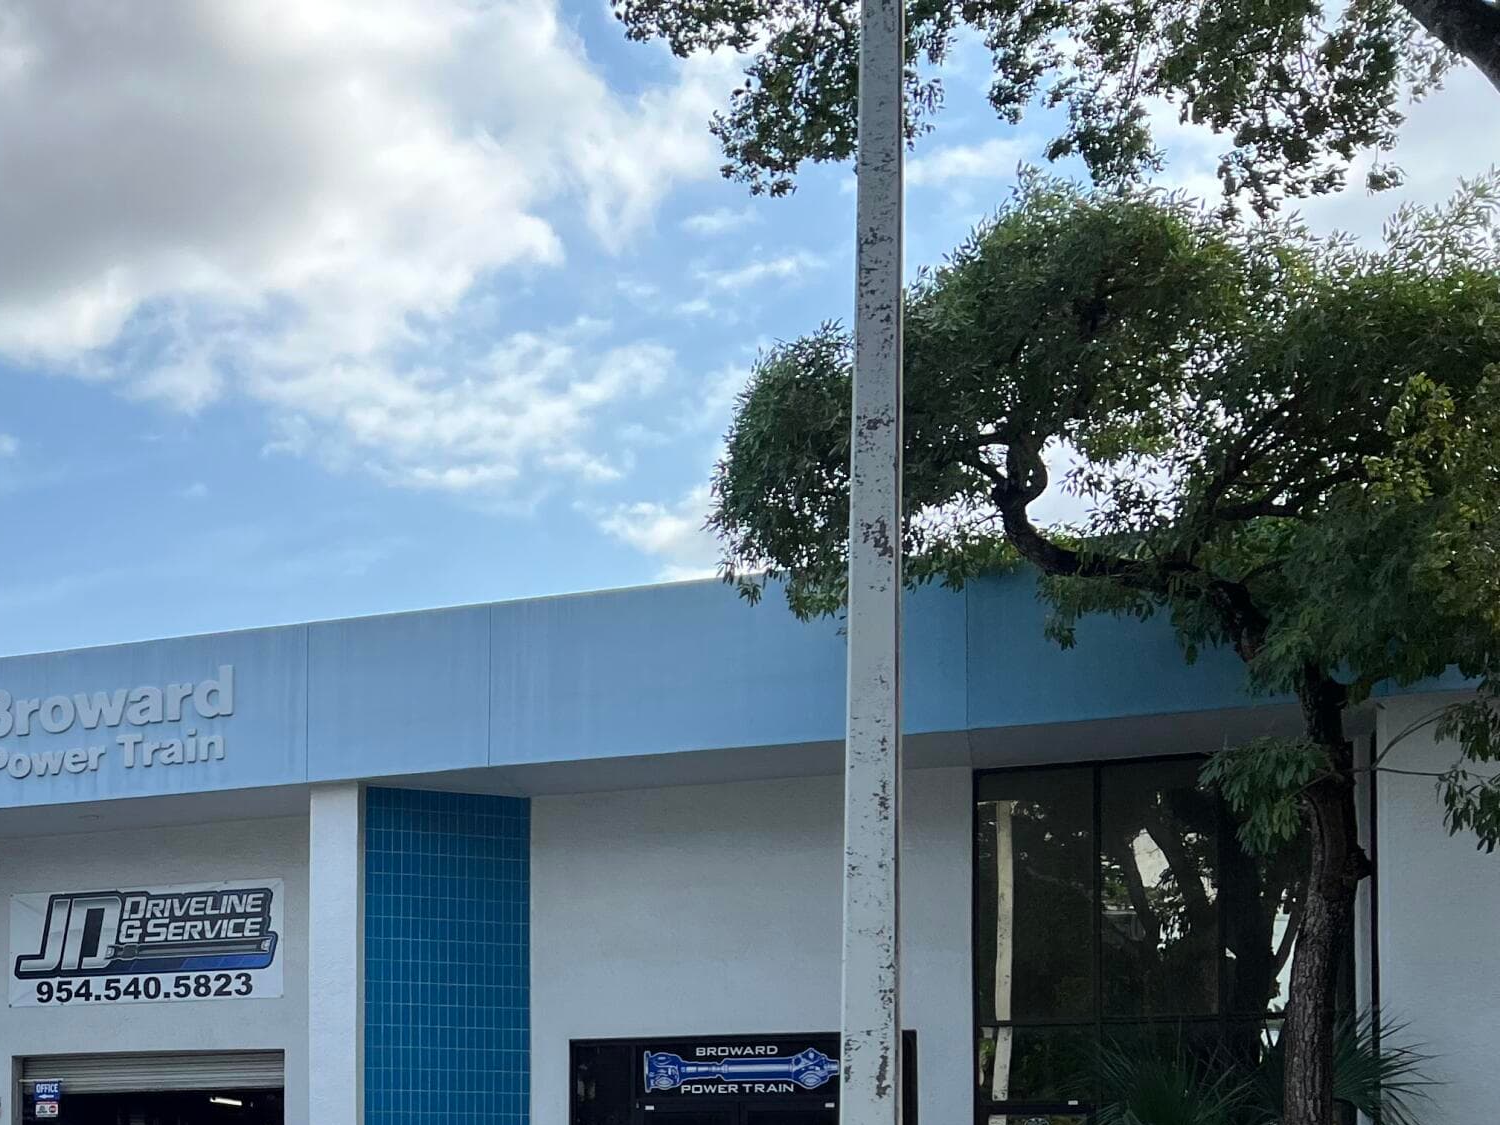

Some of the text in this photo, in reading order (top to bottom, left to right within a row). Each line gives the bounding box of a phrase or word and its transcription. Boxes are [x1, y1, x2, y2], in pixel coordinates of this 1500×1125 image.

[116, 728, 226, 768] Train
[122, 892, 265, 920] DRIVELINE
[19, 896, 121, 972] JD
[144, 916, 263, 943] SERVICE
[36, 971, 254, 1004] 954.540.5823
[695, 1045, 779, 1057] BROWARD
[35, 1083, 59, 1094] OFFICE
[681, 1083, 795, 1094] POWER TRAIN
